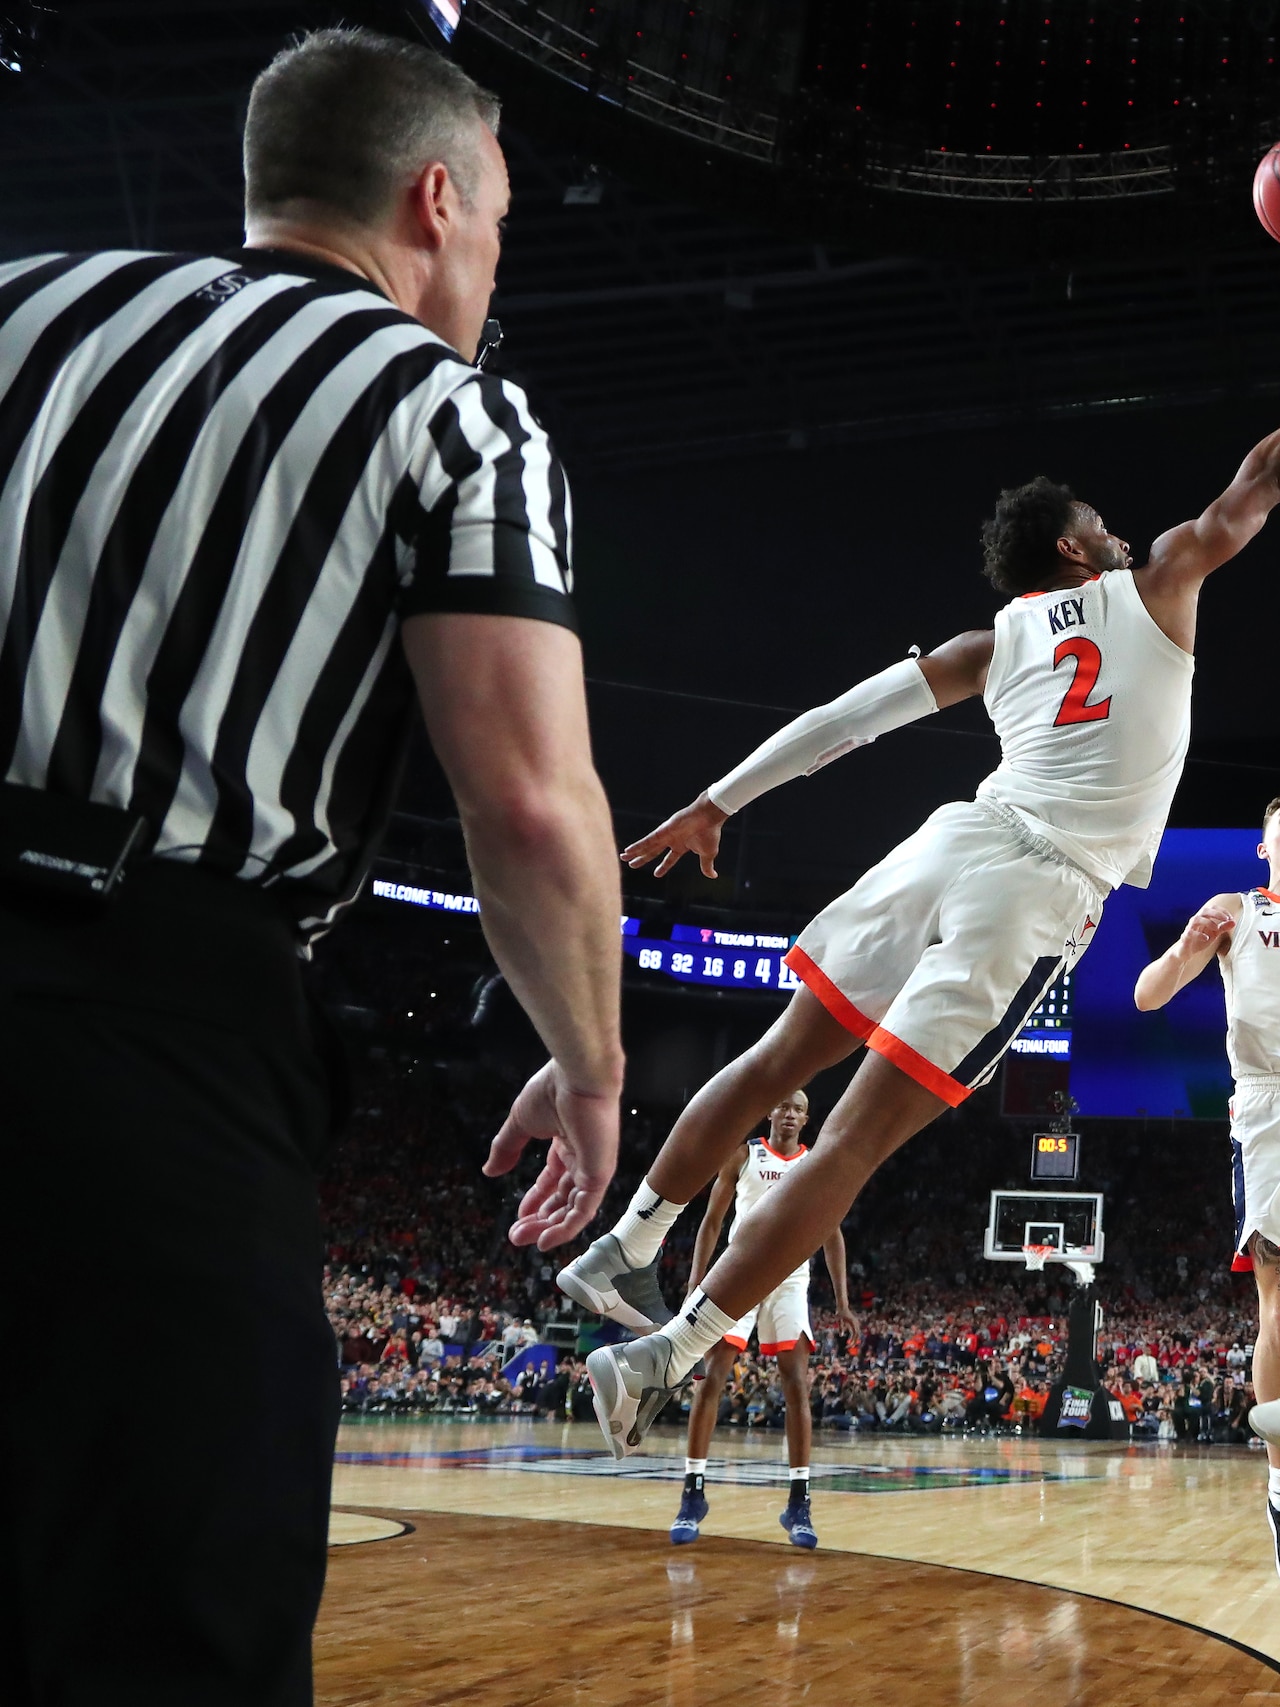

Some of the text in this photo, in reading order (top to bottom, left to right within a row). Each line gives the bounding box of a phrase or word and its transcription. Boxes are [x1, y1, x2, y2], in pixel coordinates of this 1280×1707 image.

[1048, 598, 1086, 635] KEY
[1053, 636, 1112, 727] 2
[373, 880, 431, 905] WELCOME
[432, 891, 444, 904] TO
[714, 932, 754, 947] TEXAS
[756, 936, 788, 949] TECH
[638, 949, 662, 970] 68
[671, 953, 693, 973] 32
[703, 956, 724, 977] 16
[733, 960, 746, 978] 8
[755, 958, 771, 983] 4
[1063, 1407, 1088, 1417] FOUR
[1066, 1399, 1089, 1408] FINAL
